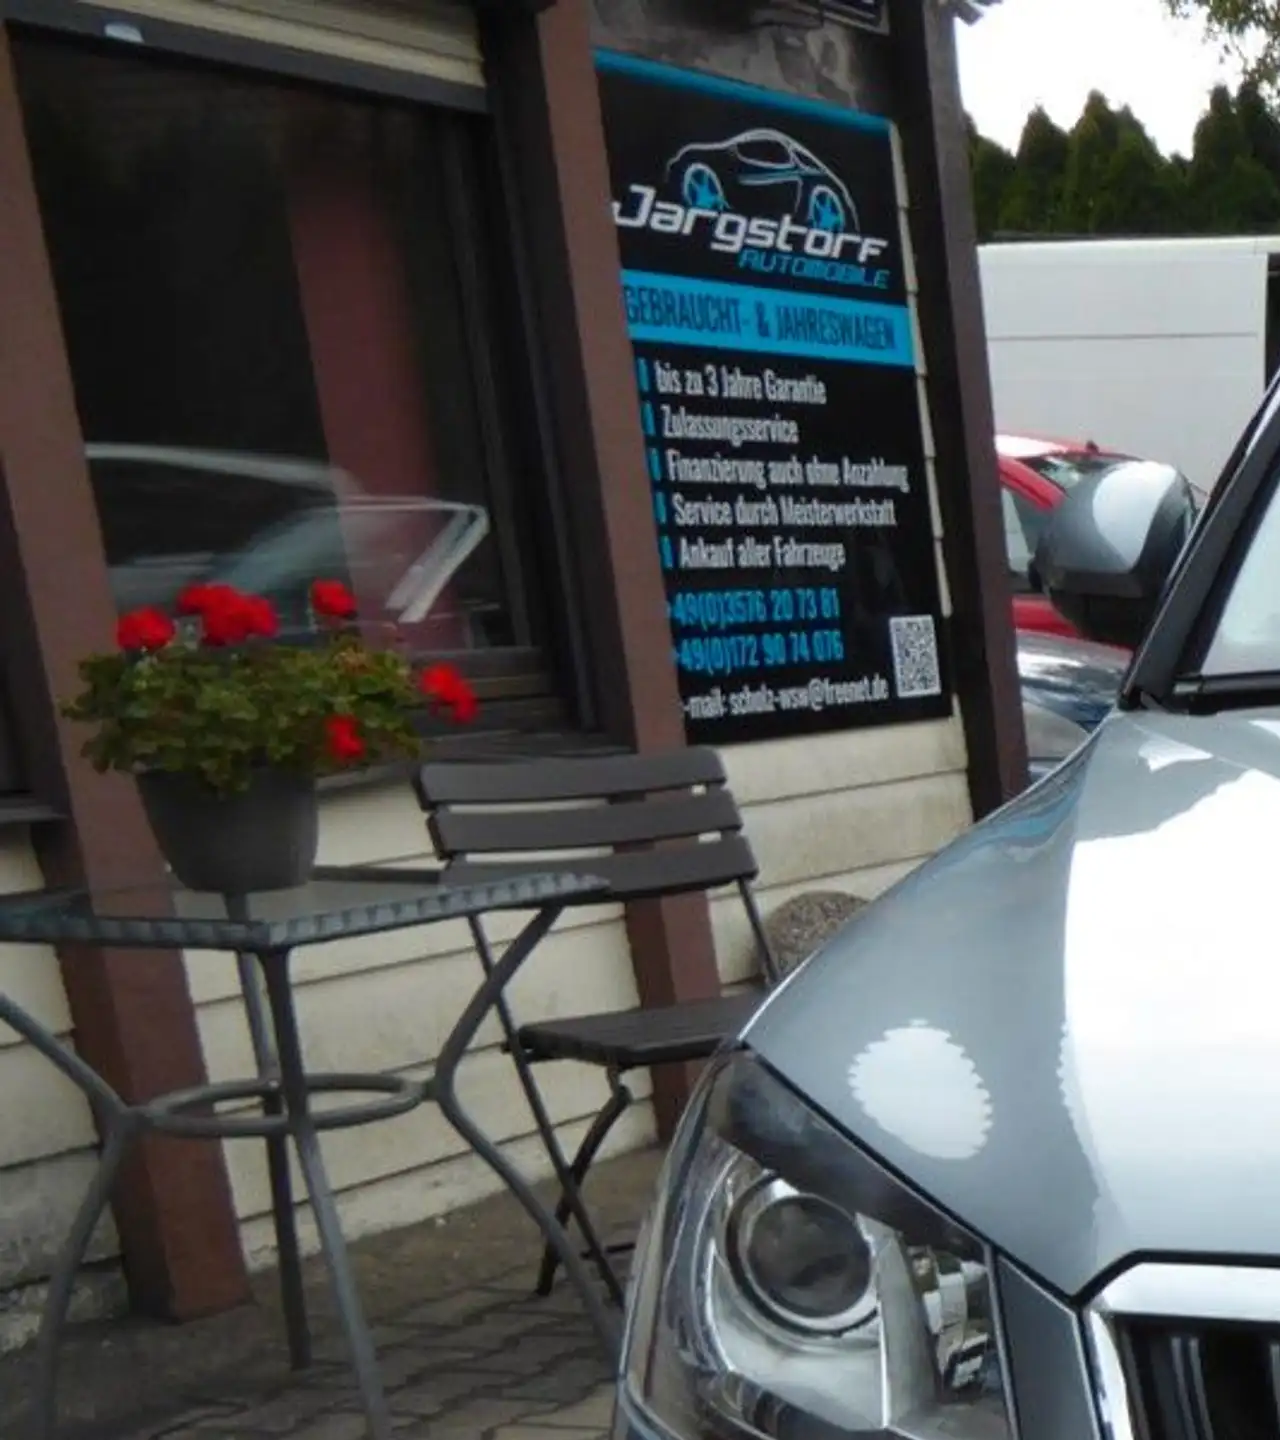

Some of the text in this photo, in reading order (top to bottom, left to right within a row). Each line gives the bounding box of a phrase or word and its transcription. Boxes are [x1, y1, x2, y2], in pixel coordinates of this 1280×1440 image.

[739, 249, 890, 288] AUTOMOBILE
[754, 301, 769, 338] &
[775, 304, 895, 350] JAHRESWAGEN
[654, 359, 827, 405] bis zu 3 Jahre Garantie
[660, 404, 799, 447] Zulassungsservice
[667, 449, 910, 493] Finanzierung auch ohne Anzahlung
[672, 492, 897, 526] Service durch Meisterwerkstatt
[680, 536, 846, 572] Ankauf aller Fahrzeuge
[771, 588, 793, 620] 20
[799, 587, 817, 620] 73
[762, 632, 786, 666] 90
[789, 630, 811, 664] 74
